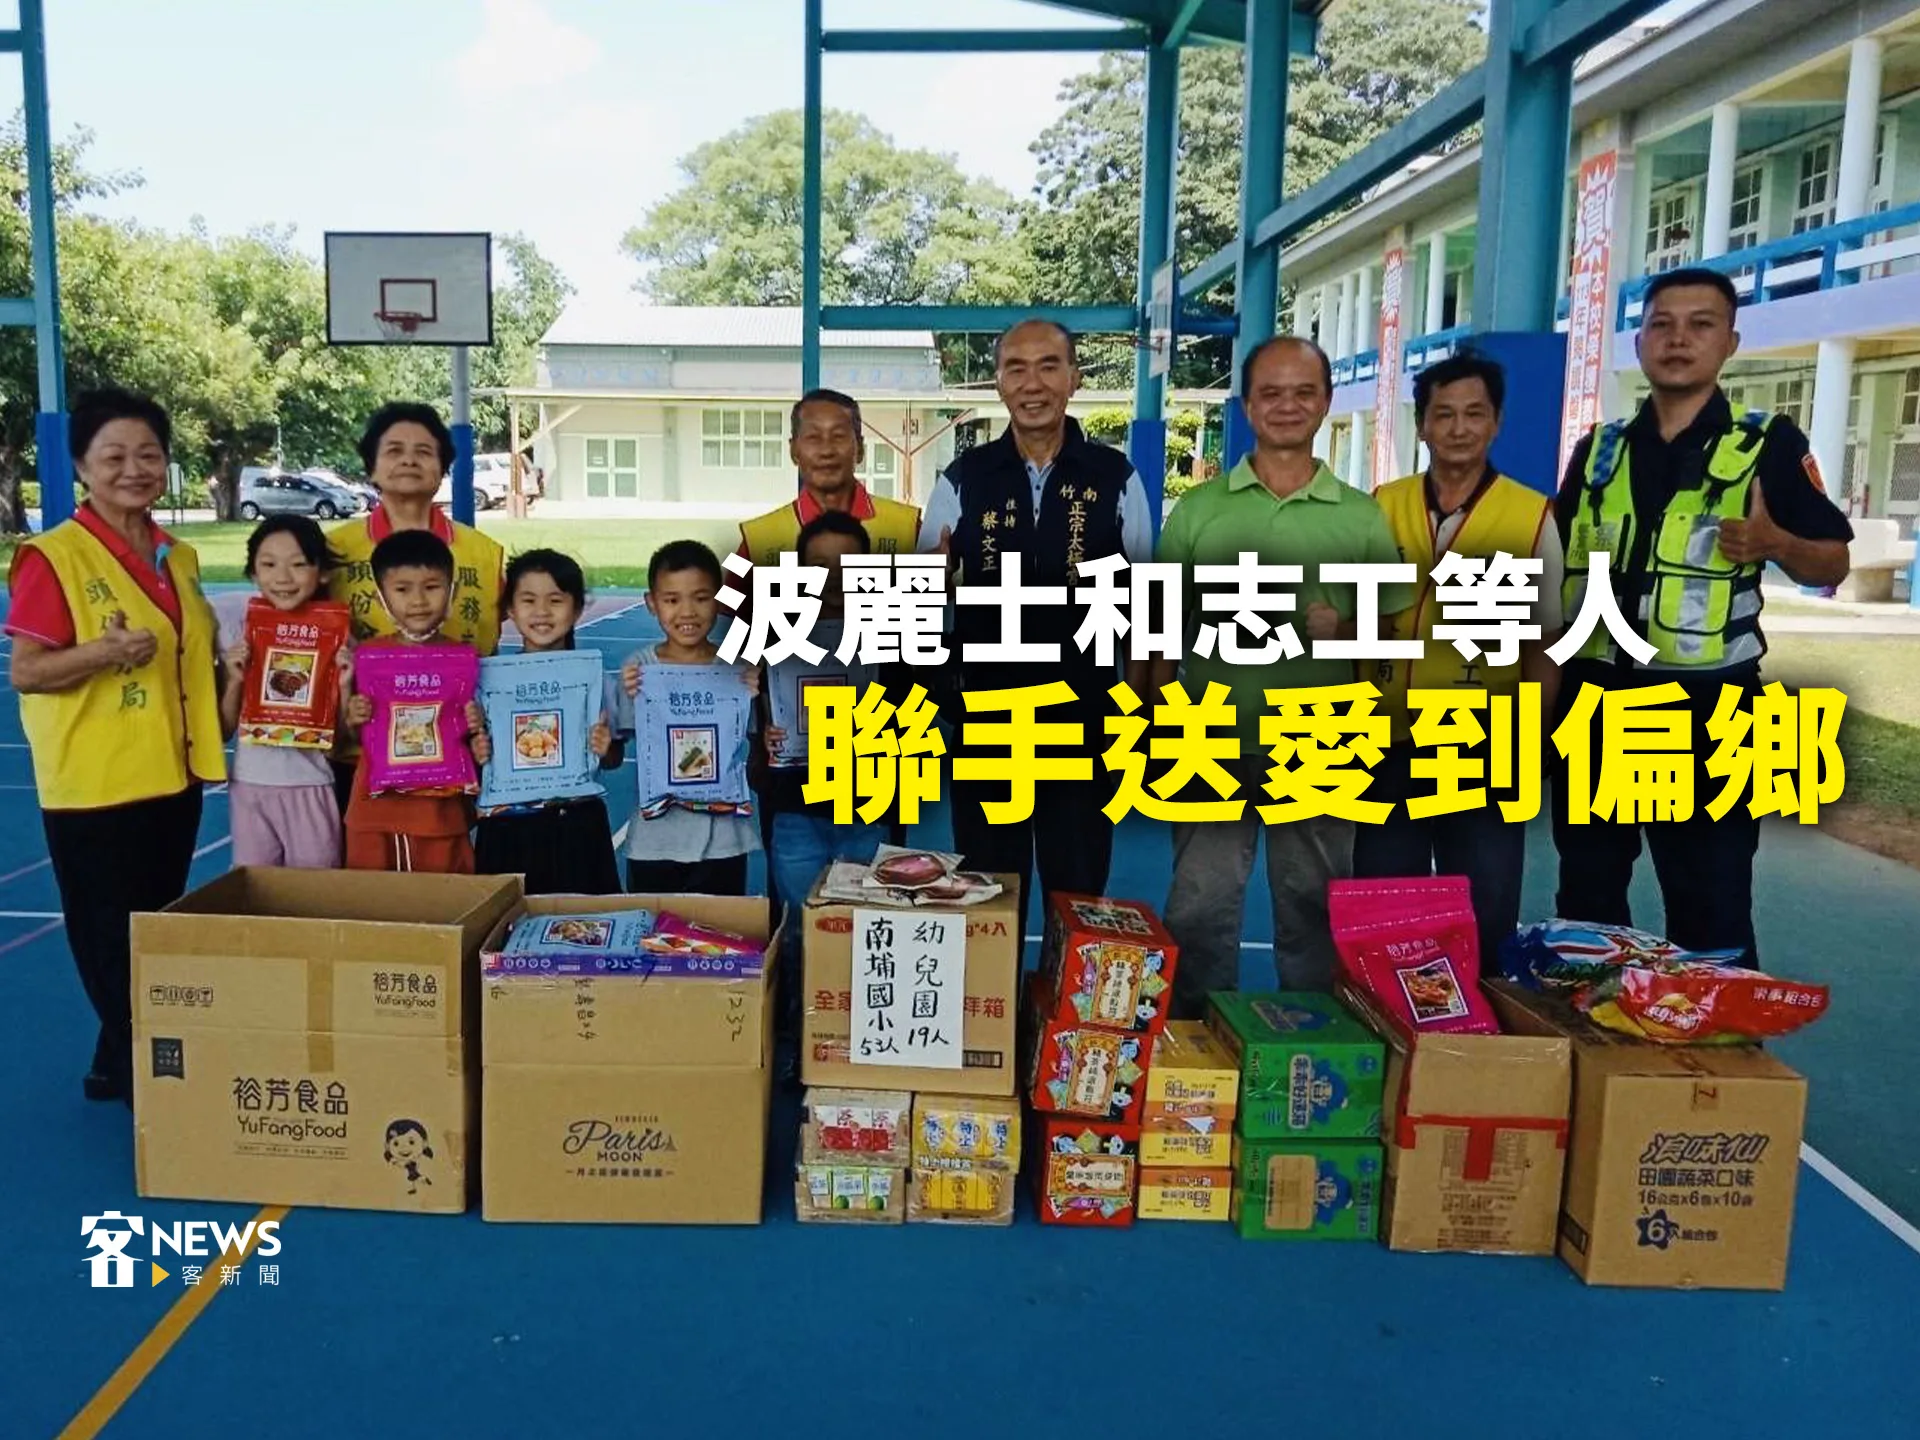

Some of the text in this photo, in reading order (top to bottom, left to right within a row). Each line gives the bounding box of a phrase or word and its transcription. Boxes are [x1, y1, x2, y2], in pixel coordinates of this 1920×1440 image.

[373, 972, 437, 994] 裕芳食品
[865, 917, 897, 1032] 南埔國小
[912, 920, 944, 1018] 幼兒園
[232, 1076, 348, 1115] 裕芳食品
[237, 1115, 347, 1141] YuFangFood
[562, 1120, 667, 1155] Paris
[597, 1152, 644, 1162] MOON
[1639, 1132, 1770, 1165] 浪味仙
